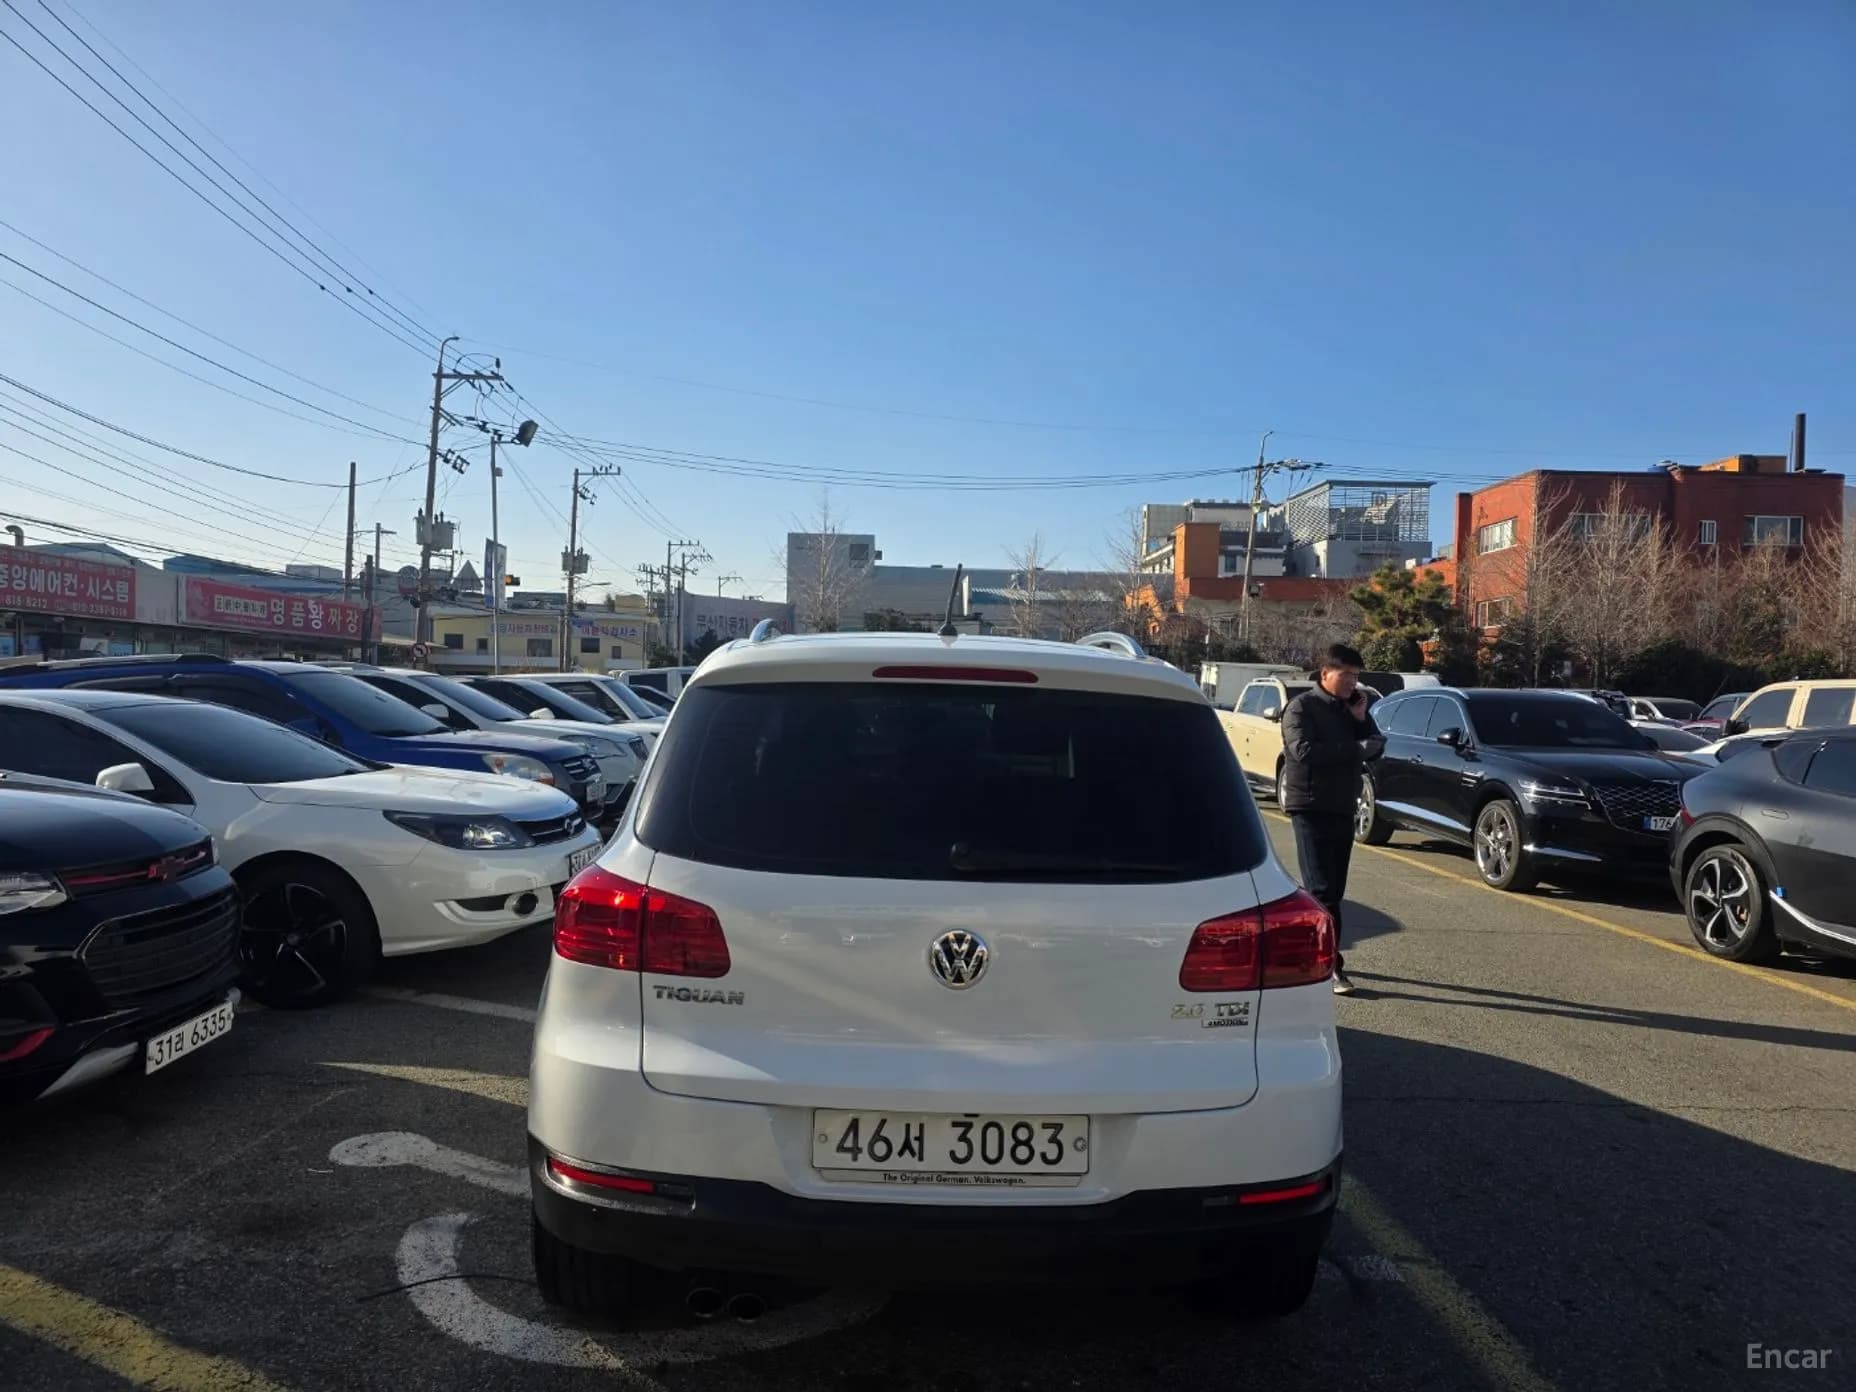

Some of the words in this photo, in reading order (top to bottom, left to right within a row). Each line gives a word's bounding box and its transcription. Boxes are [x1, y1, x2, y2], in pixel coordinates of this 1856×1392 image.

[653, 985, 744, 1005] TIGUAN
[1214, 1001, 1250, 1017] TDI
[191, 1007, 226, 1046] 6335
[836, 1117, 925, 1163] 46서
[948, 1121, 1065, 1166] 3083
[883, 1173, 897, 1182] The
[900, 1173, 933, 1184] Original
